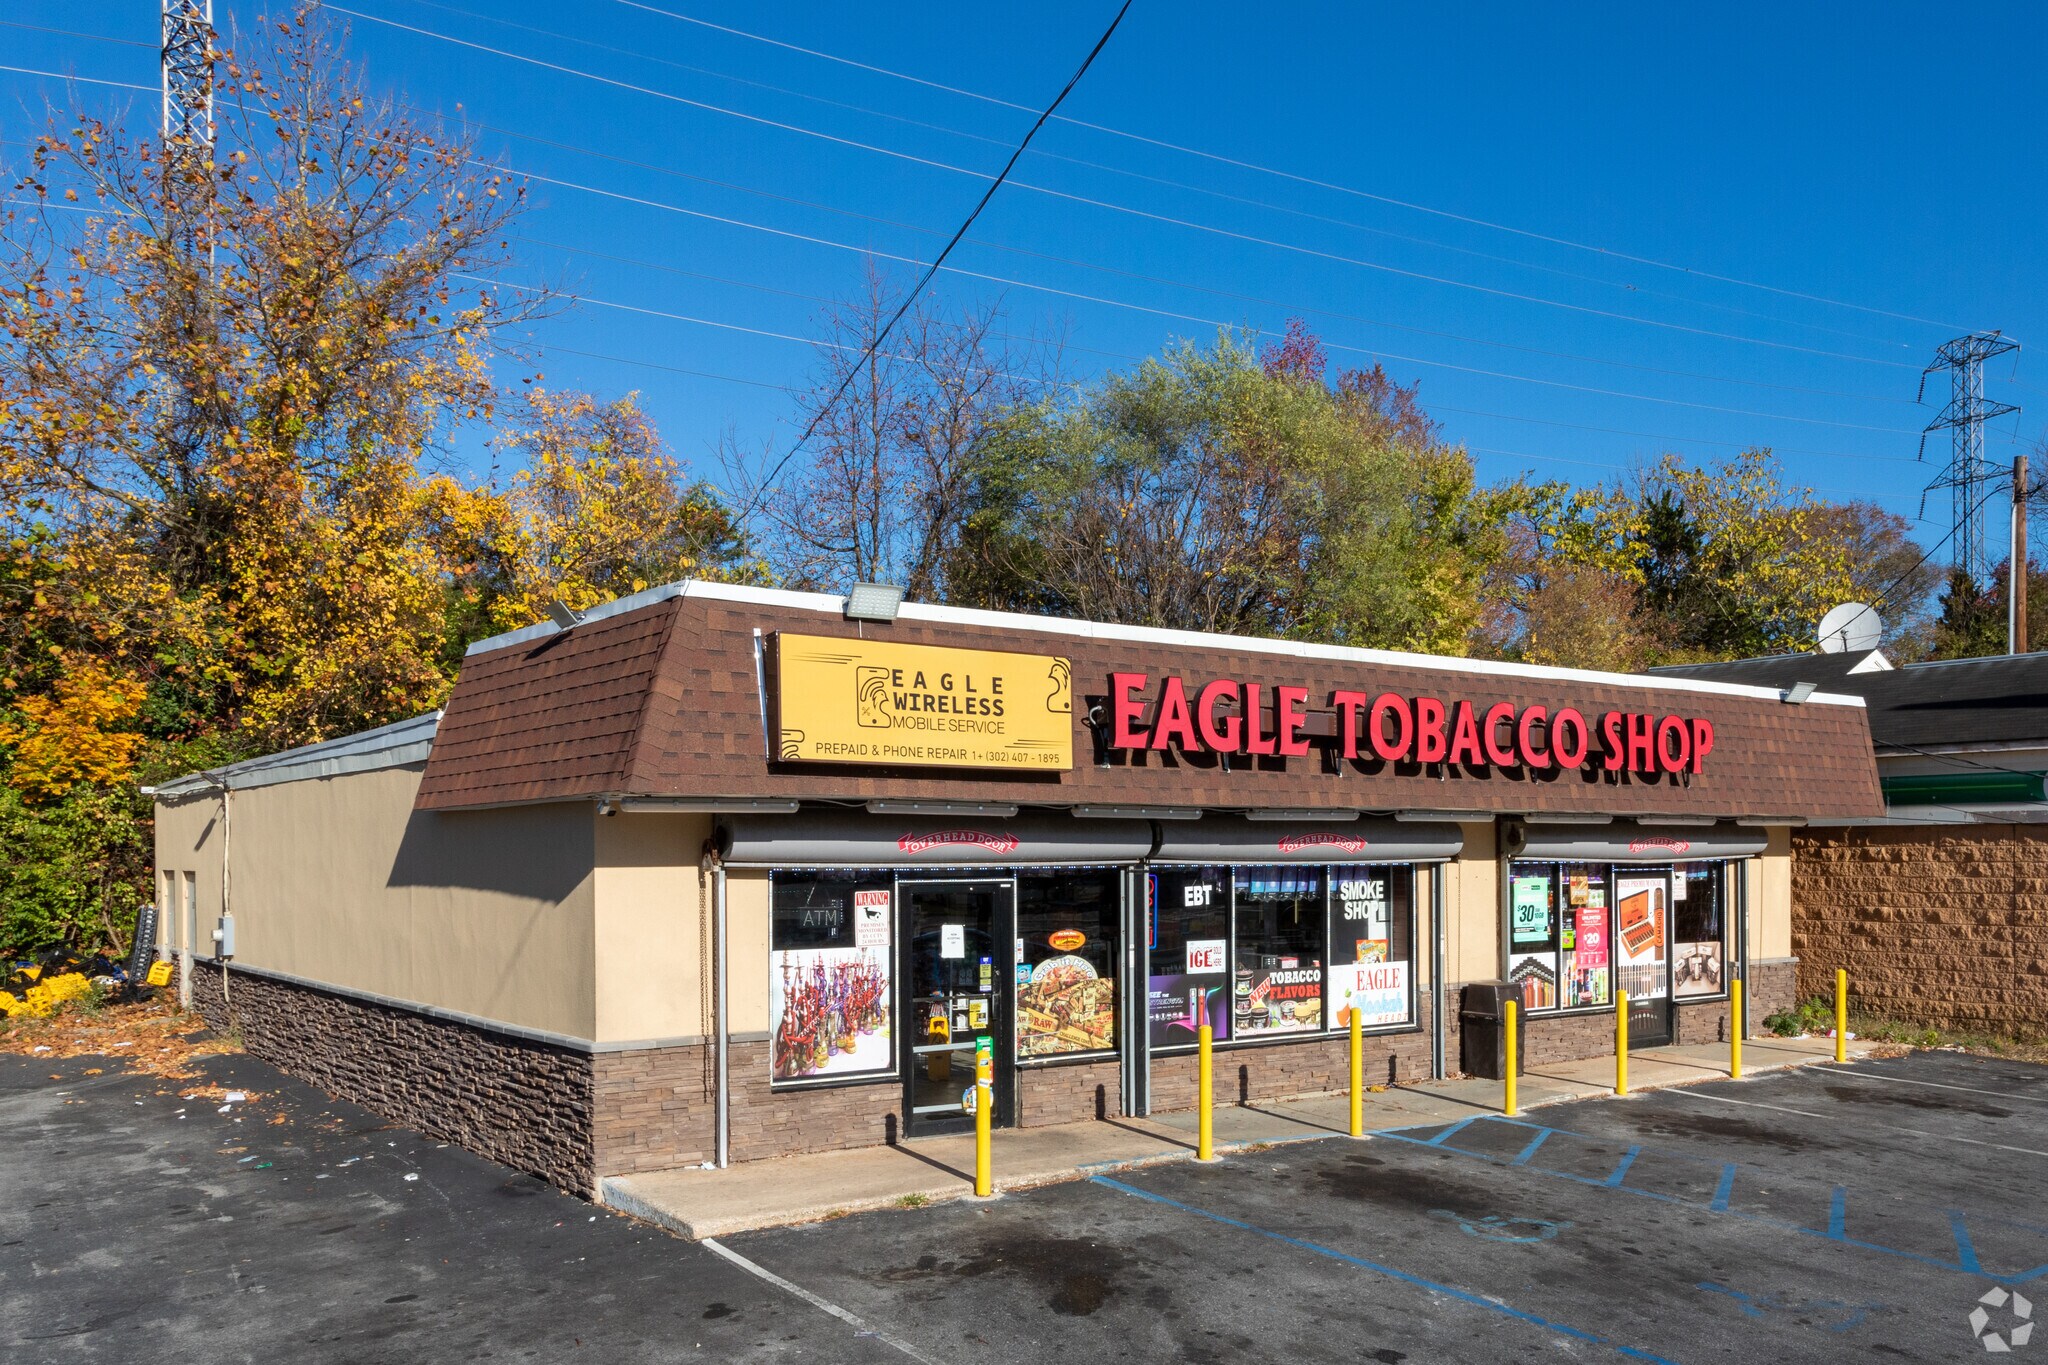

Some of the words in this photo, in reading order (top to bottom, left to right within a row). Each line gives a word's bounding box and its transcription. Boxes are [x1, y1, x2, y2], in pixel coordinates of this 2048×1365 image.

[892, 668, 1003, 695] EAGLE
[893, 691, 1004, 717] WIRELESS
[892, 715, 946, 732] MOBILE
[948, 717, 1005, 735] SERVICE
[1111, 671, 1310, 758] EAGLE
[1332, 689, 1589, 770] TOBACCO
[1603, 711, 1715, 775] SHOP
[815, 742, 868, 756] PREPAID
[871, 744, 880, 757] &
[883, 745, 924, 758] PHONE
[927, 747, 967, 761] REPAIR
[985, 750, 1010, 763] (302)
[1011, 752, 1029, 763] 407
[1038, 753, 1060, 764] 1895
[911, 831, 975, 852] OVERHEAD
[977, 833, 1006, 853] DOOR
[1286, 834, 1334, 851] OVERHEAD
[1335, 836, 1357, 853] DOOR
[856, 892, 888, 906] WARNING
[1184, 884, 1212, 907] EBT
[1340, 880, 1384, 901] SMOKE
[803, 909, 837, 927] ATM
[1344, 901, 1379, 920] SHOP
[1517, 904, 1535, 922] $30
[1583, 932, 1600, 944] $20
[1189, 948, 1213, 968] ICE
[1034, 961, 1058, 981] Grab
[1073, 958, 1093, 979] Here
[1269, 969, 1321, 985] TOBACCO
[1356, 967, 1401, 991] EAGLE
[1250, 980, 1270, 1006] NEW
[1269, 984, 1321, 1000] FLAVORS
[1033, 1016, 1053, 1029] RAW
